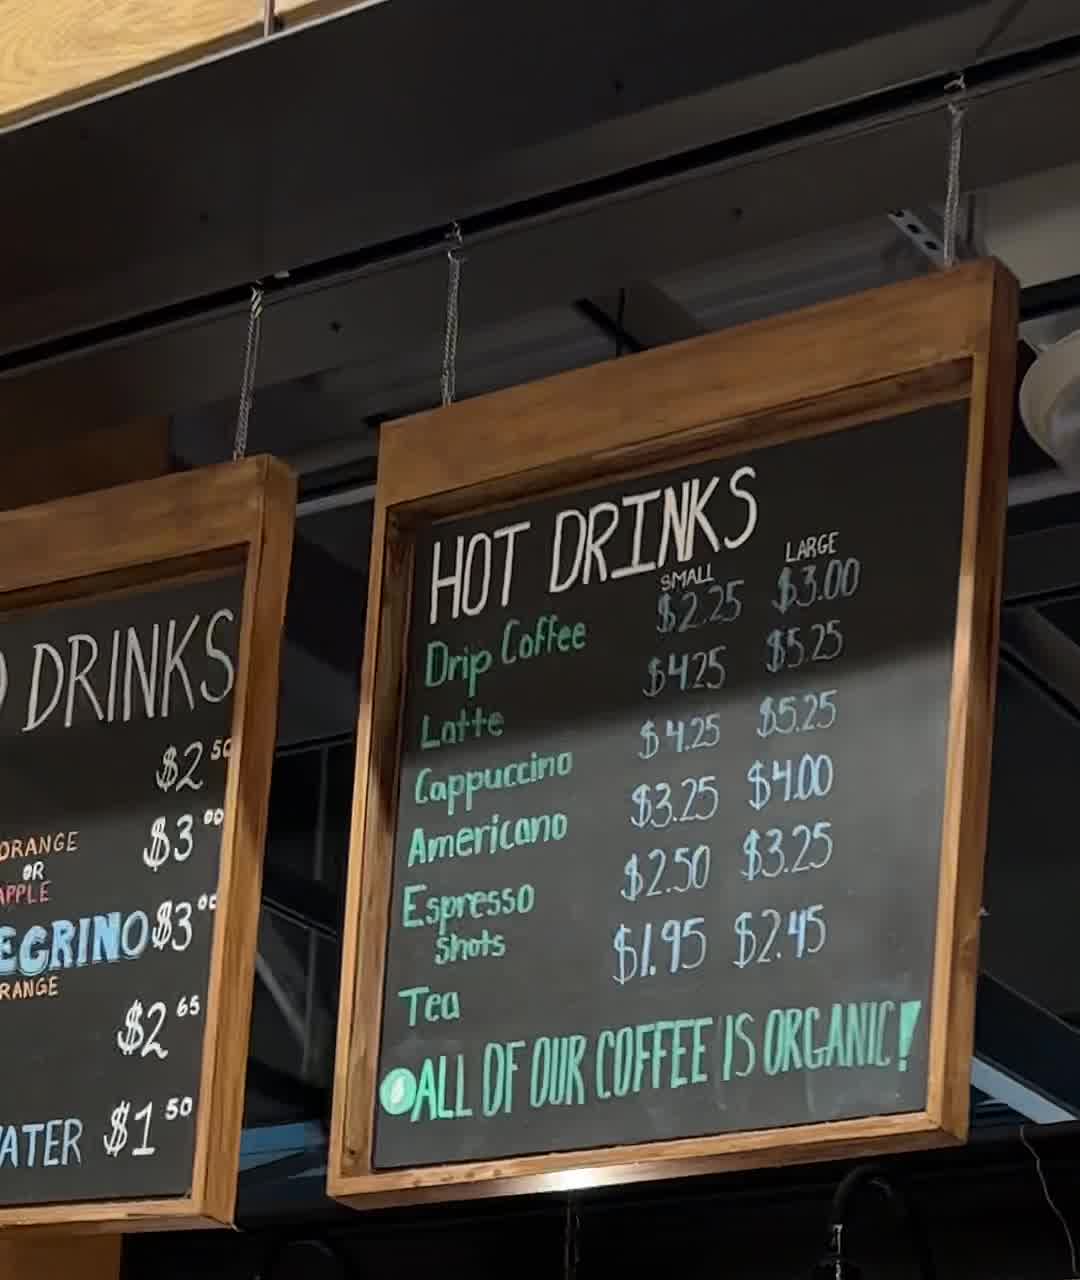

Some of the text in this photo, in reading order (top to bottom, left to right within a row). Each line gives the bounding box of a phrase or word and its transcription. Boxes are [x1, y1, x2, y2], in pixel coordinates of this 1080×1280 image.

[429, 466, 758, 625] HOT DRINKS
[661, 563, 715, 592] SMALL
[785, 532, 839, 562] LARGE
[22, 609, 234, 732] DRINKS
[425, 558, 860, 697] Drip Coffee $2.25 $3.00
[415, 689, 837, 816] Cappuccino $4.25 $5.25
[421, 707, 505, 750] Latte
[0, 831, 80, 861] ORANGE
[22, 861, 45, 881] OR
[407, 813, 568, 867] Americano
[631, 775, 719, 829] $3.25
[403, 821, 833, 935] Espresso $2.50 $3.25
[398, 904, 826, 1026] Tea $1.95 $2.45
[410, 1000, 922, 1122] ALL OF OUR COFFEE IS ORGANIC!
[0, 1118, 83, 1168] ATER
